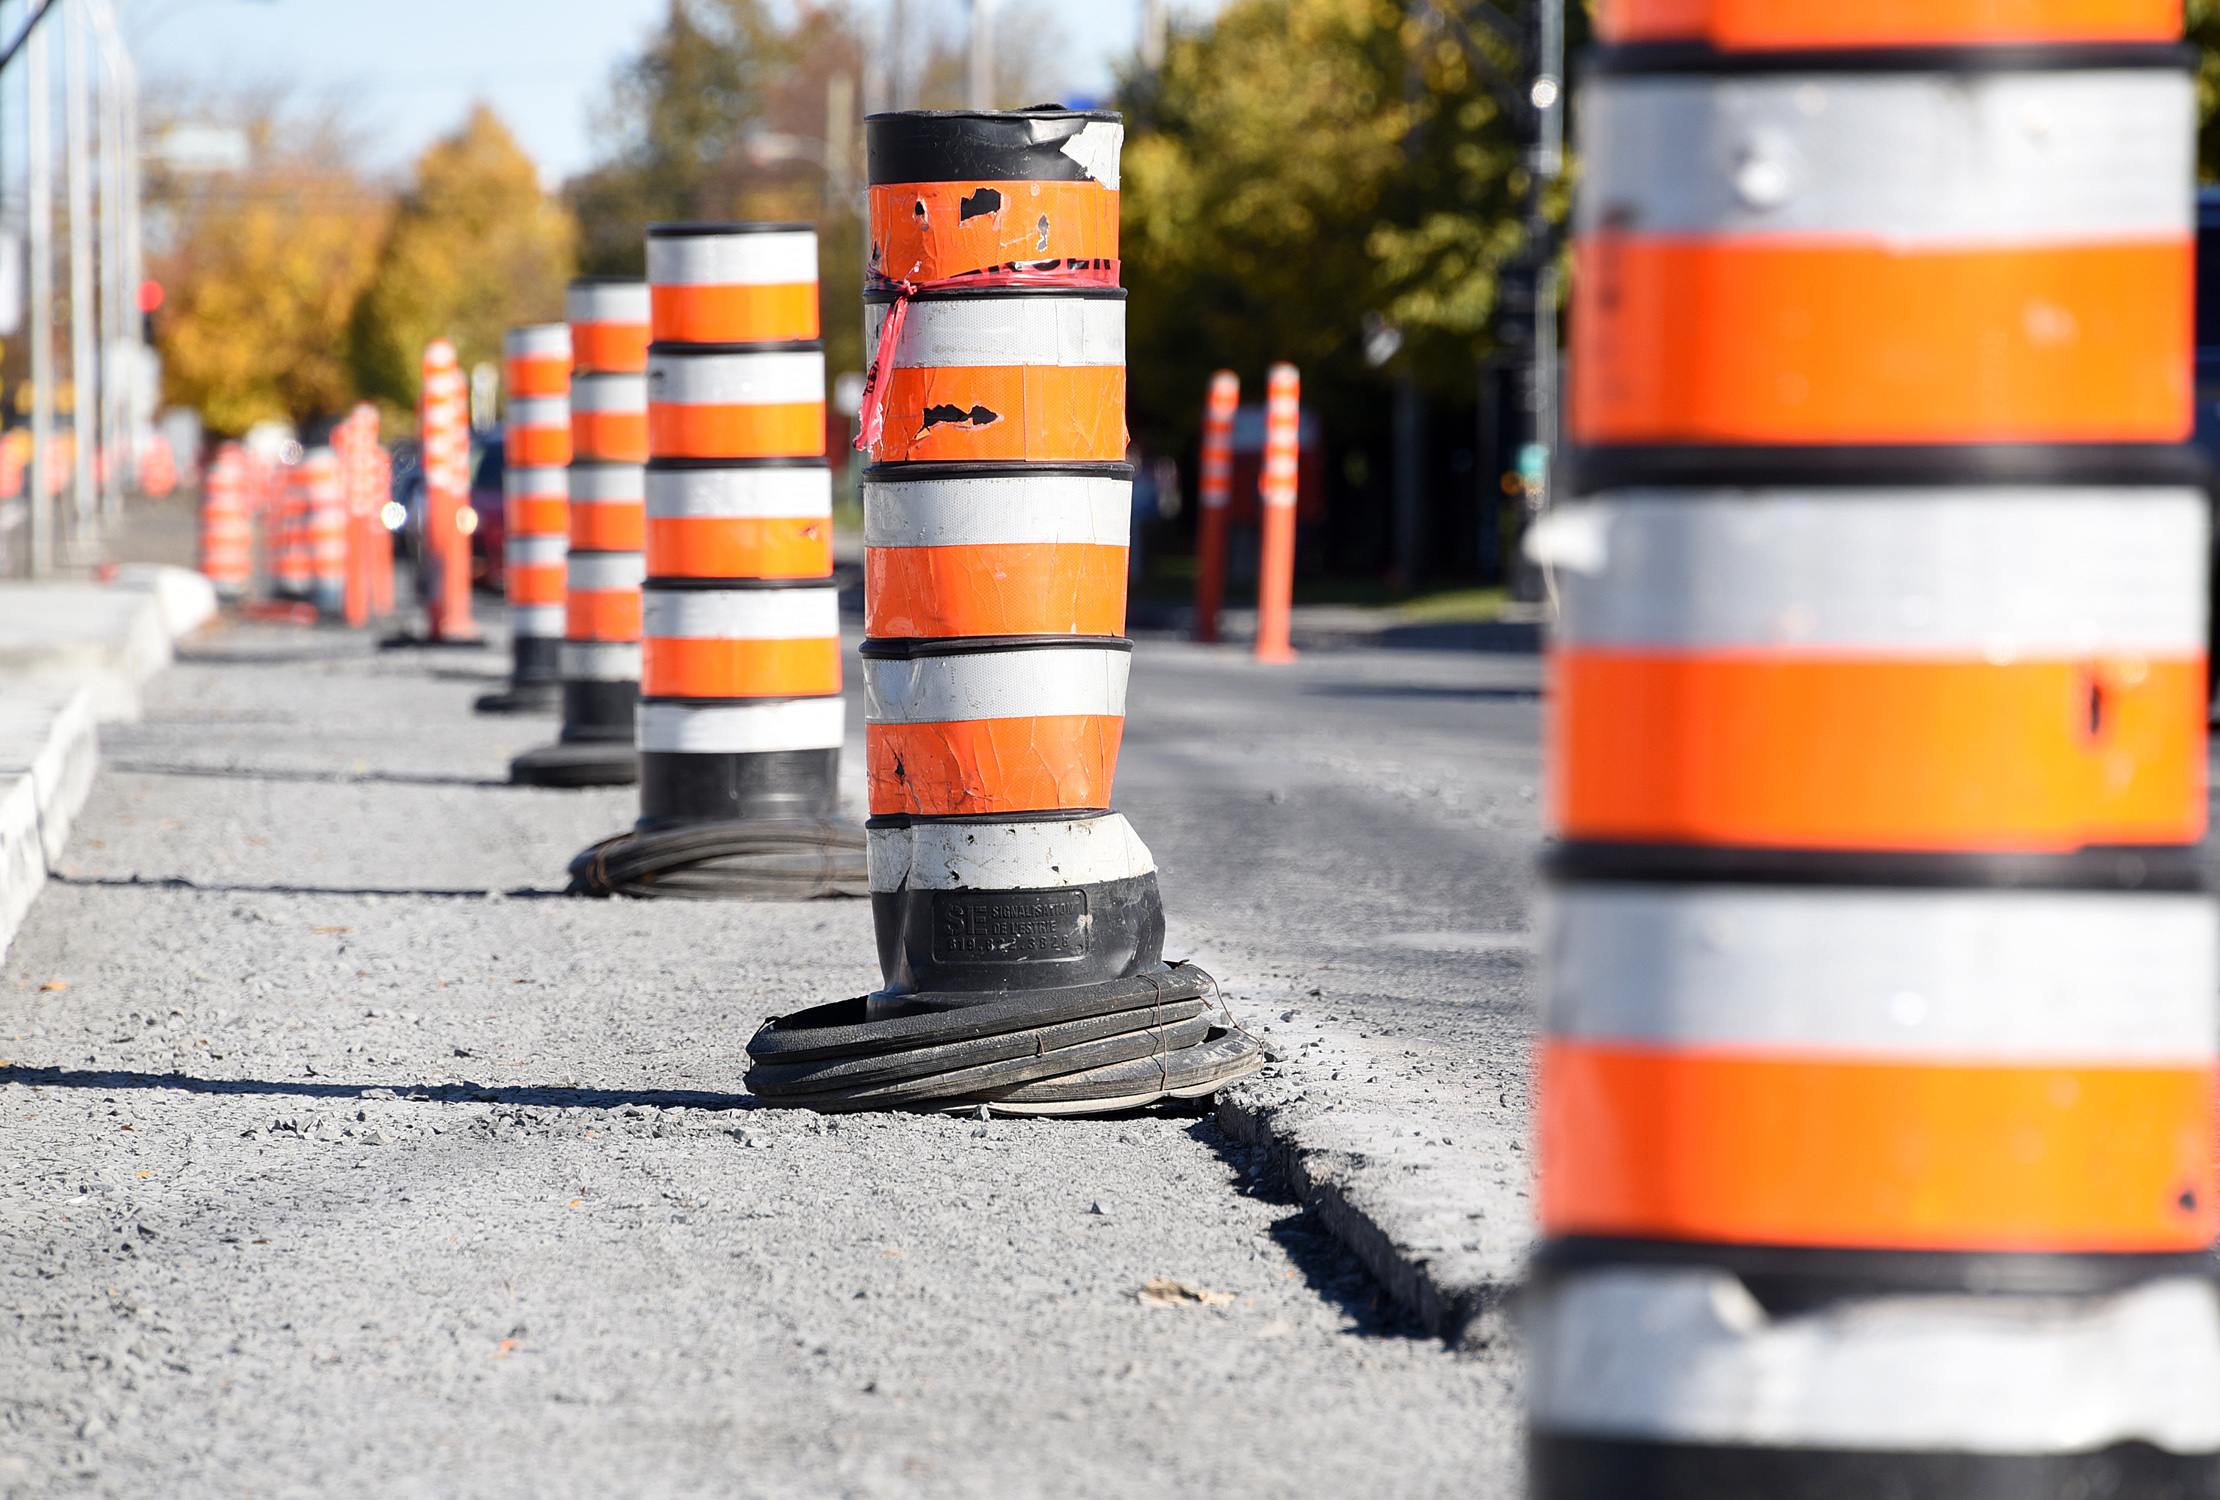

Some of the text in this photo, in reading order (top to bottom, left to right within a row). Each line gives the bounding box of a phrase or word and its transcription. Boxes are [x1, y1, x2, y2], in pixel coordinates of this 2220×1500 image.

[991, 902, 1075, 919] SIGNALISATION
[992, 920, 1057, 935] DE L'ESTRIE
